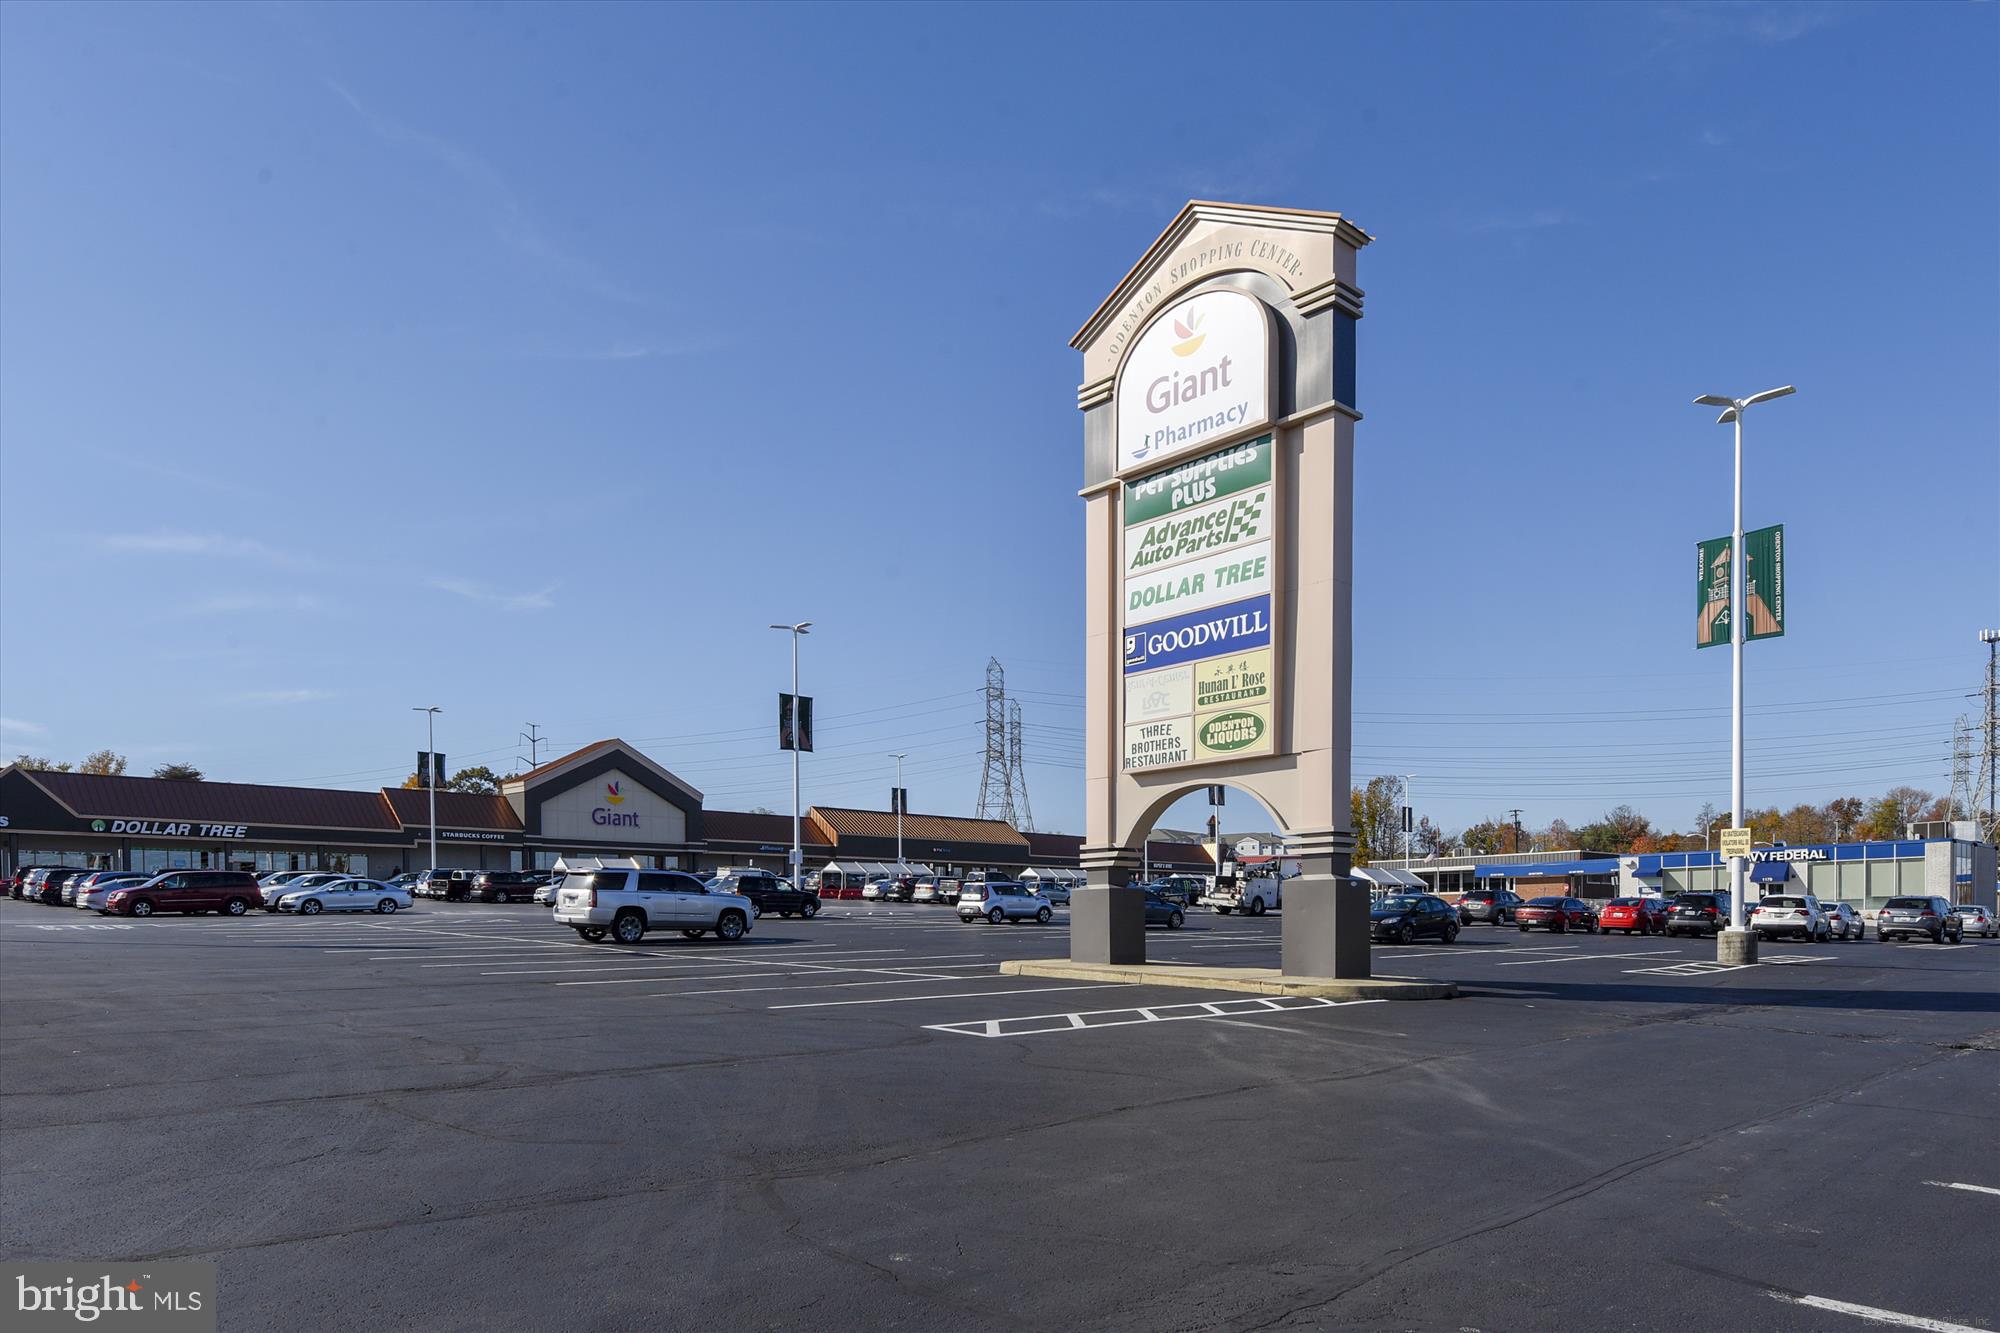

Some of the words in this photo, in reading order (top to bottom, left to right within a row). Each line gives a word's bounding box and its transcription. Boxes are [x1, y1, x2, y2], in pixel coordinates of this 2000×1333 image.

[1110, 282, 1163, 354] ODENTON
[1170, 241, 1243, 284] SHOPPING
[1250, 239, 1299, 277] CENTER
[1146, 354, 1233, 414] Giant
[1155, 402, 1248, 450] Pharmacy
[1171, 477, 1216, 510] PLUS
[1140, 506, 1227, 549] Advance
[1129, 573, 1205, 611] DOLLAR
[1215, 556, 1267, 588] TREE
[1148, 610, 1267, 655] GOODWILL
[1199, 677, 1228, 695] Hunan
[1242, 671, 1265, 687] Rose
[1204, 687, 1261, 704] RESTAURANT
[1140, 723, 1173, 740] THREE
[1209, 716, 1254, 733] ODENTON
[1131, 737, 1181, 755] BROTHERS
[1206, 728, 1257, 746] LIQUORS
[1126, 749, 1188, 769] RESTAURANT
[591, 807, 640, 828] Giant
[111, 820, 191, 836] DOLLAR
[199, 824, 248, 838] TREE
[1770, 849, 1827, 861] FEDERAL
